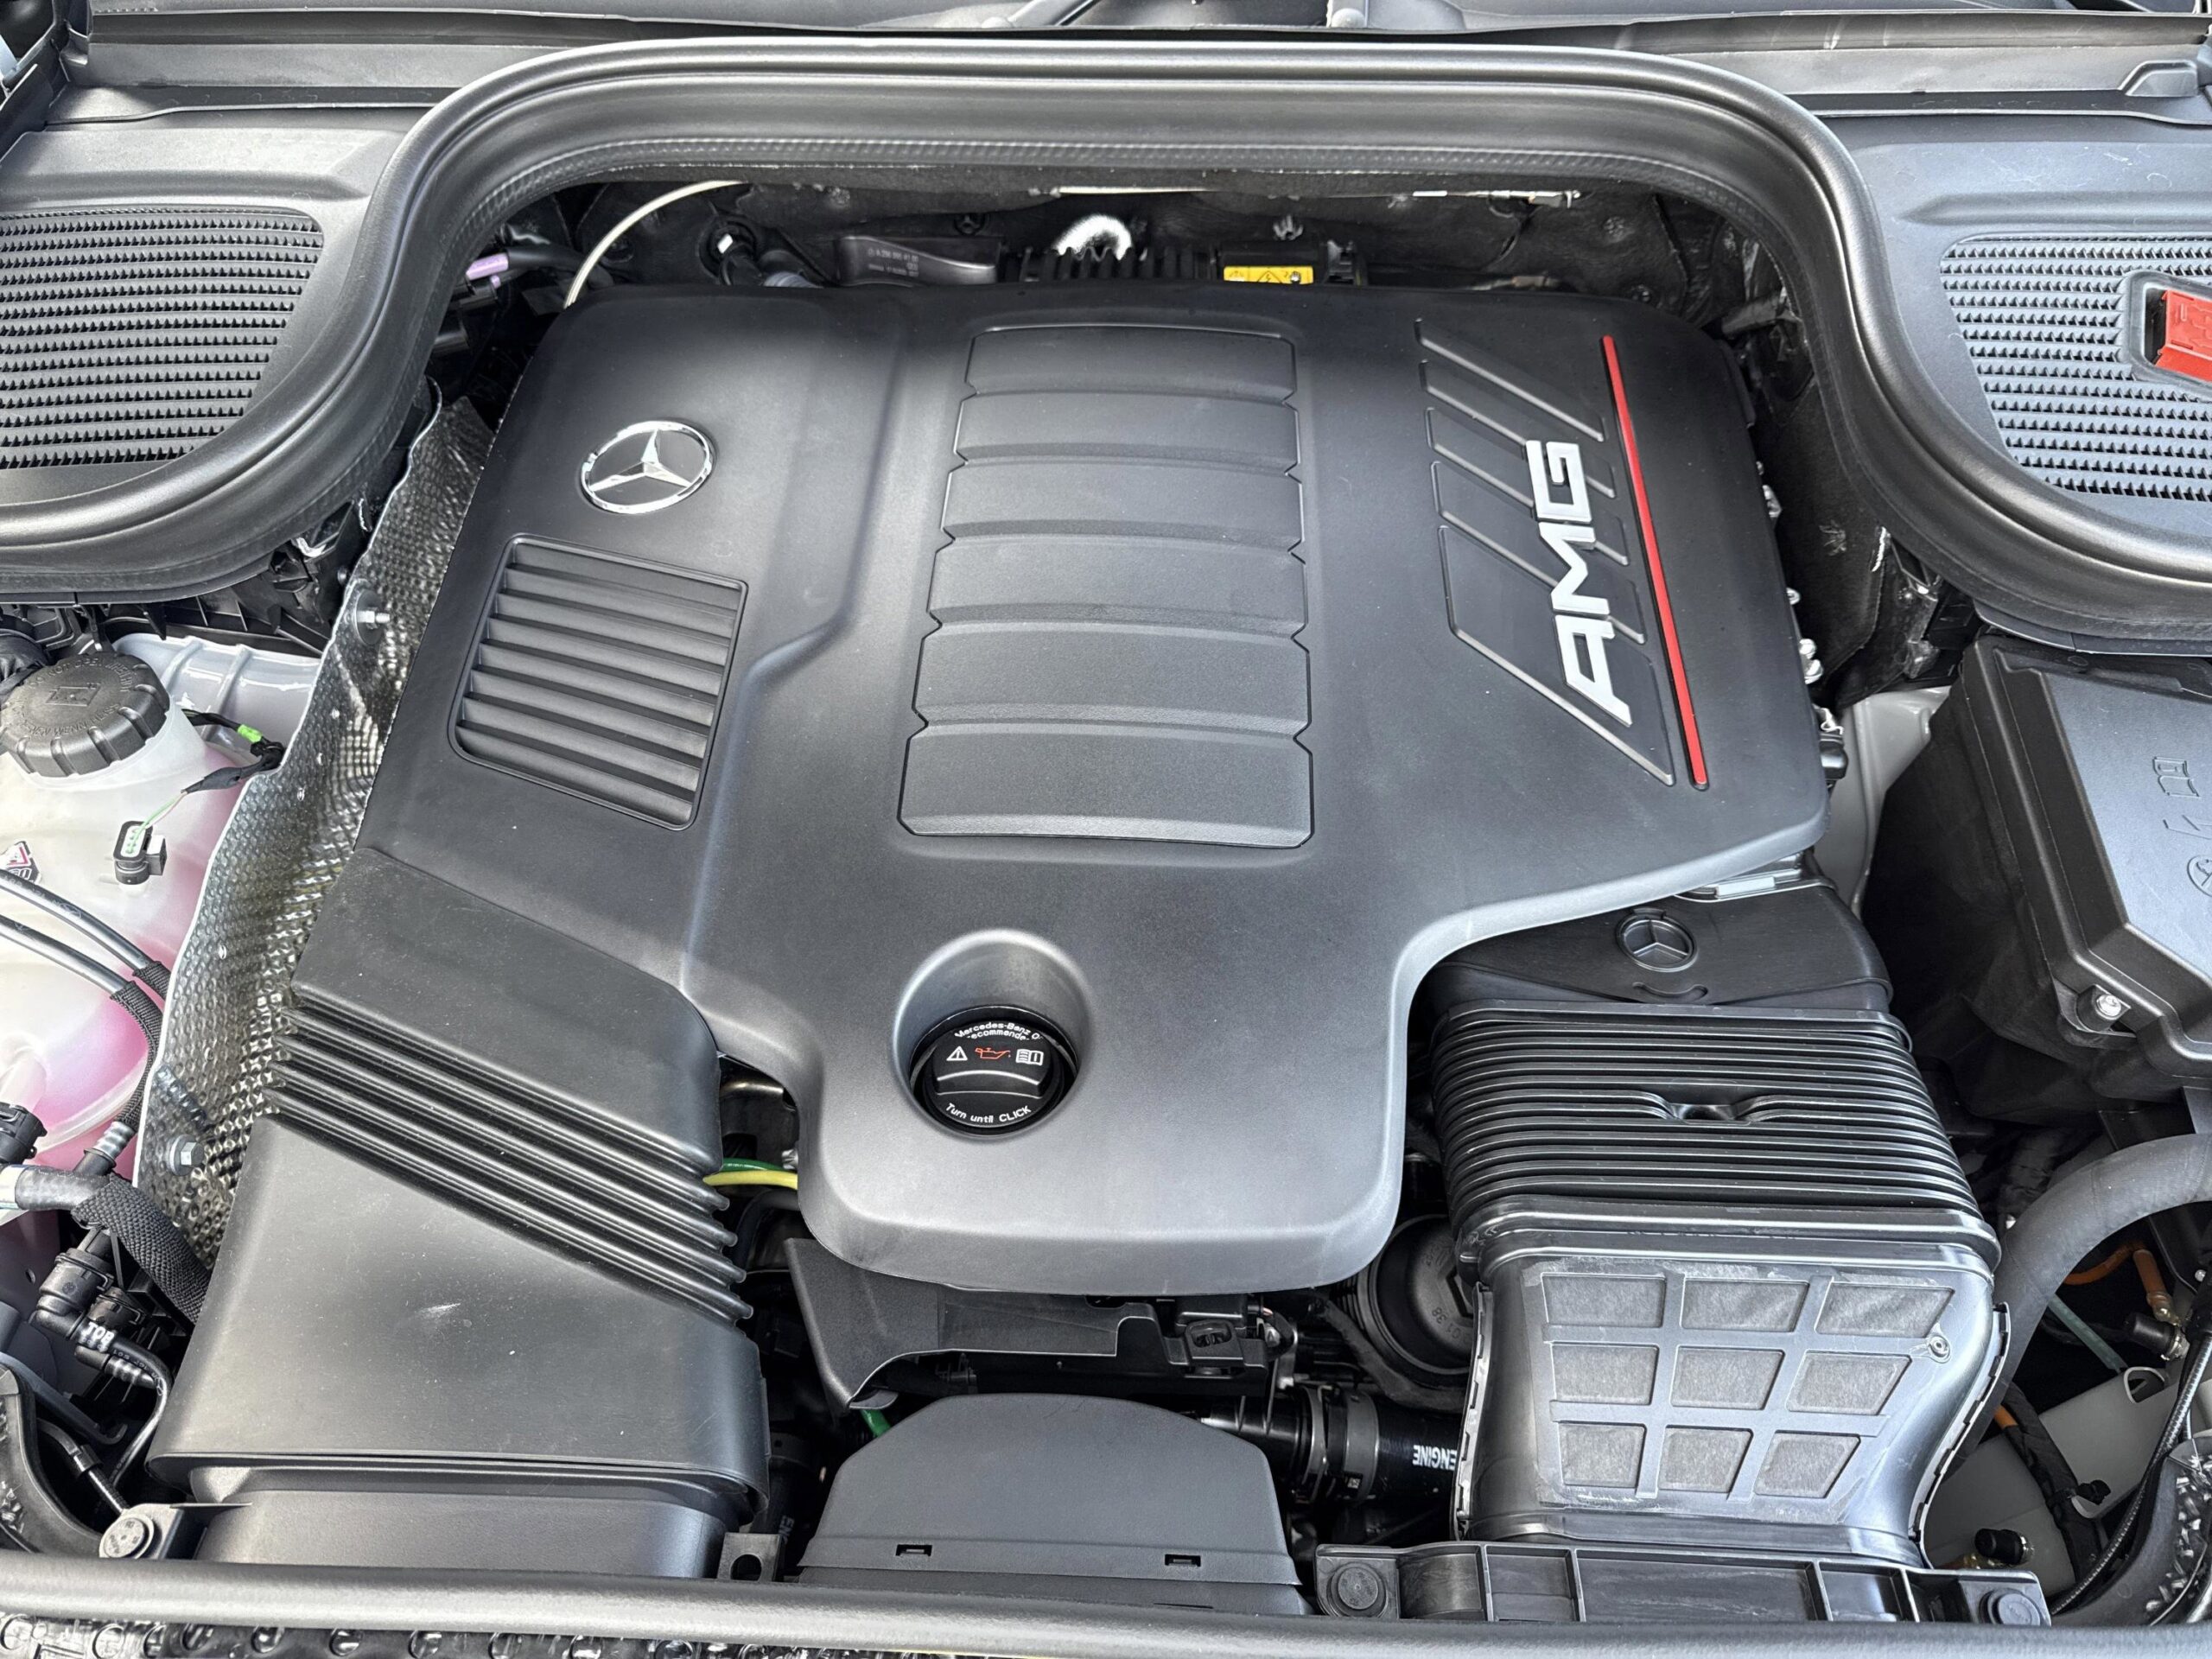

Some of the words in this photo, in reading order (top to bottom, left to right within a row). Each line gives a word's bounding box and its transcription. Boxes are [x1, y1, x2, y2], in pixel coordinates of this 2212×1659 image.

[1526, 440, 1632, 727] AMG
[954, 1021, 1032, 1037] Mercedes-Benz
[967, 1029, 1030, 1040] ecommende
[946, 1102, 967, 1119] Turn
[969, 1115, 994, 1123] until
[999, 1105, 1032, 1122] CLICK
[1412, 1445, 1458, 1471] ENGINE
